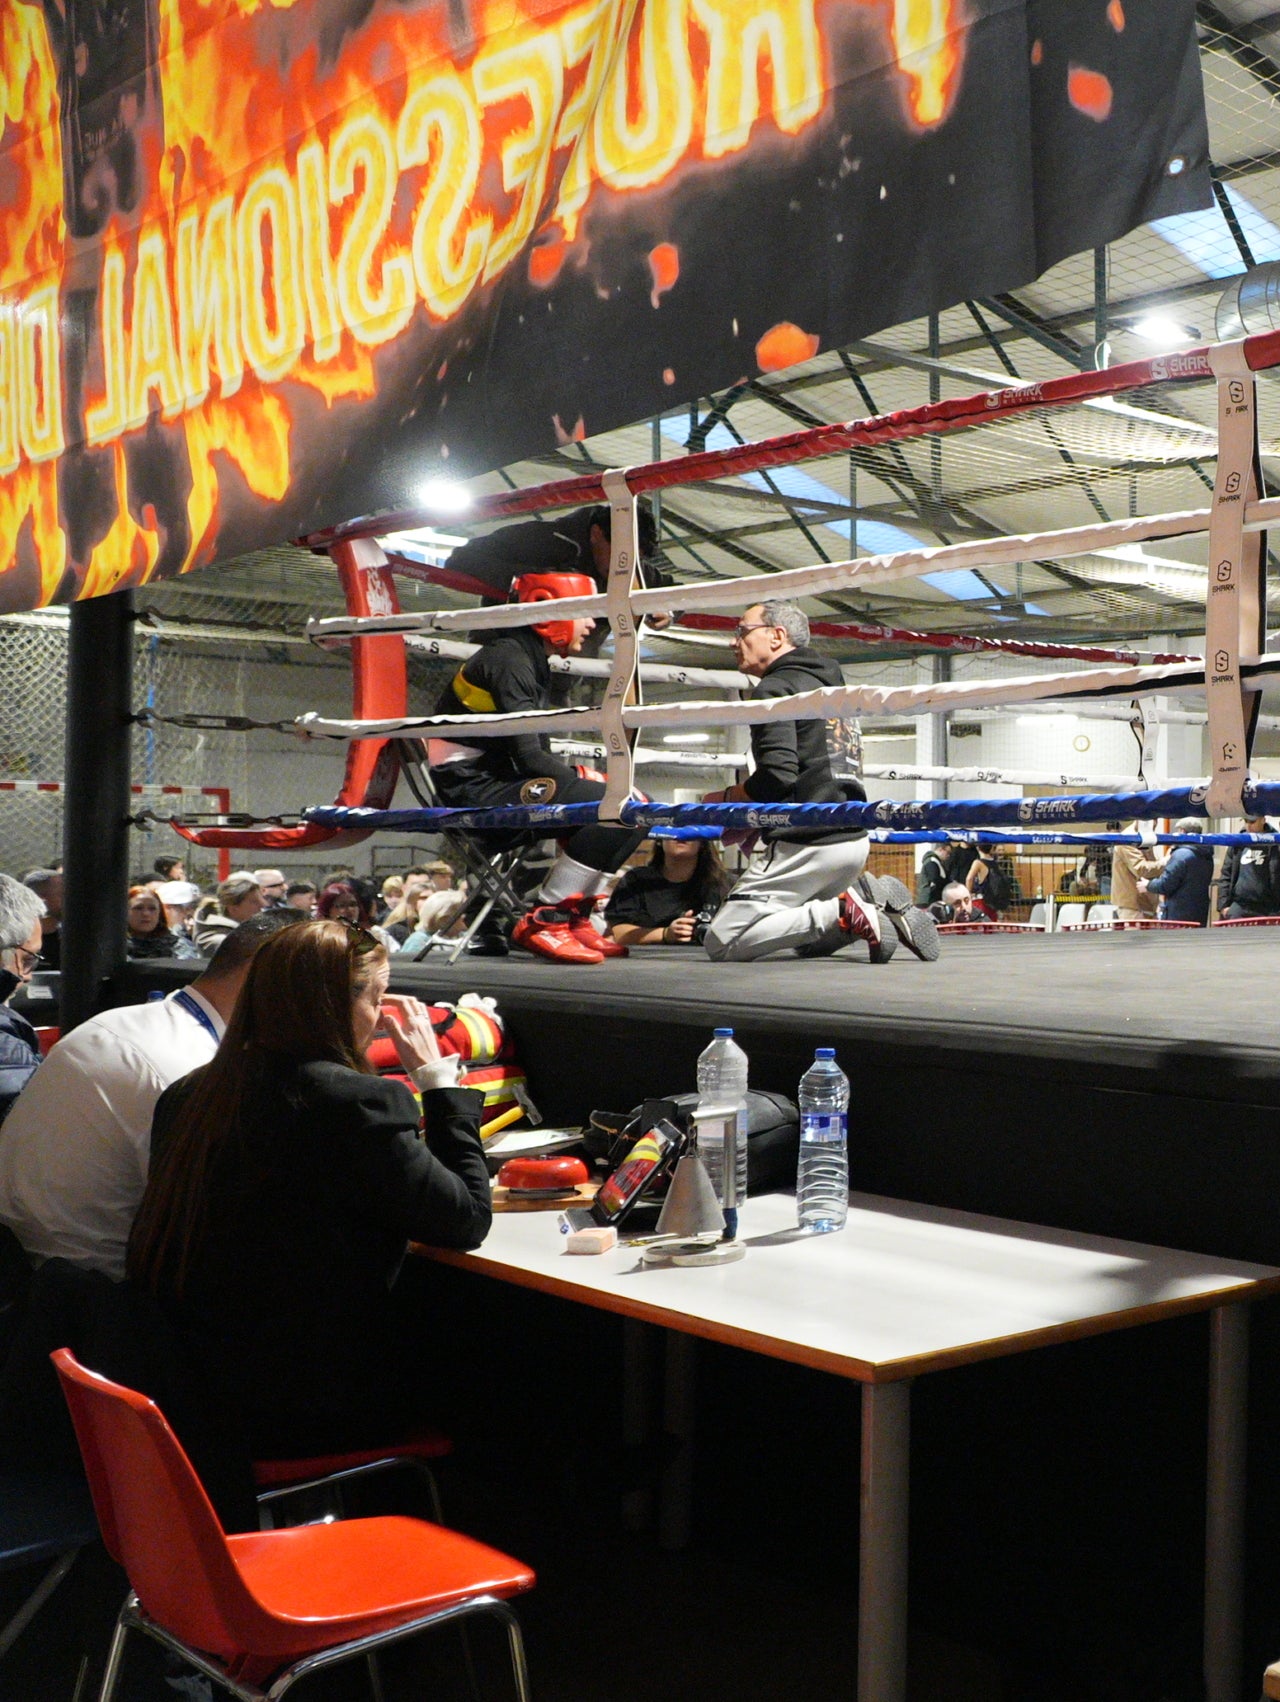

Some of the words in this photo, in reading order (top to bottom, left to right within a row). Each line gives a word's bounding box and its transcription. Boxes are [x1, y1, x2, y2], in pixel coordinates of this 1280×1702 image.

[1170, 356, 1210, 373] SHAR
[1226, 405, 1249, 416] SARK
[1212, 584, 1235, 594] SHARK
[1211, 675, 1234, 684] SHARK
[1034, 800, 1077, 813] SHARK
[760, 814, 791, 826] SHARK
